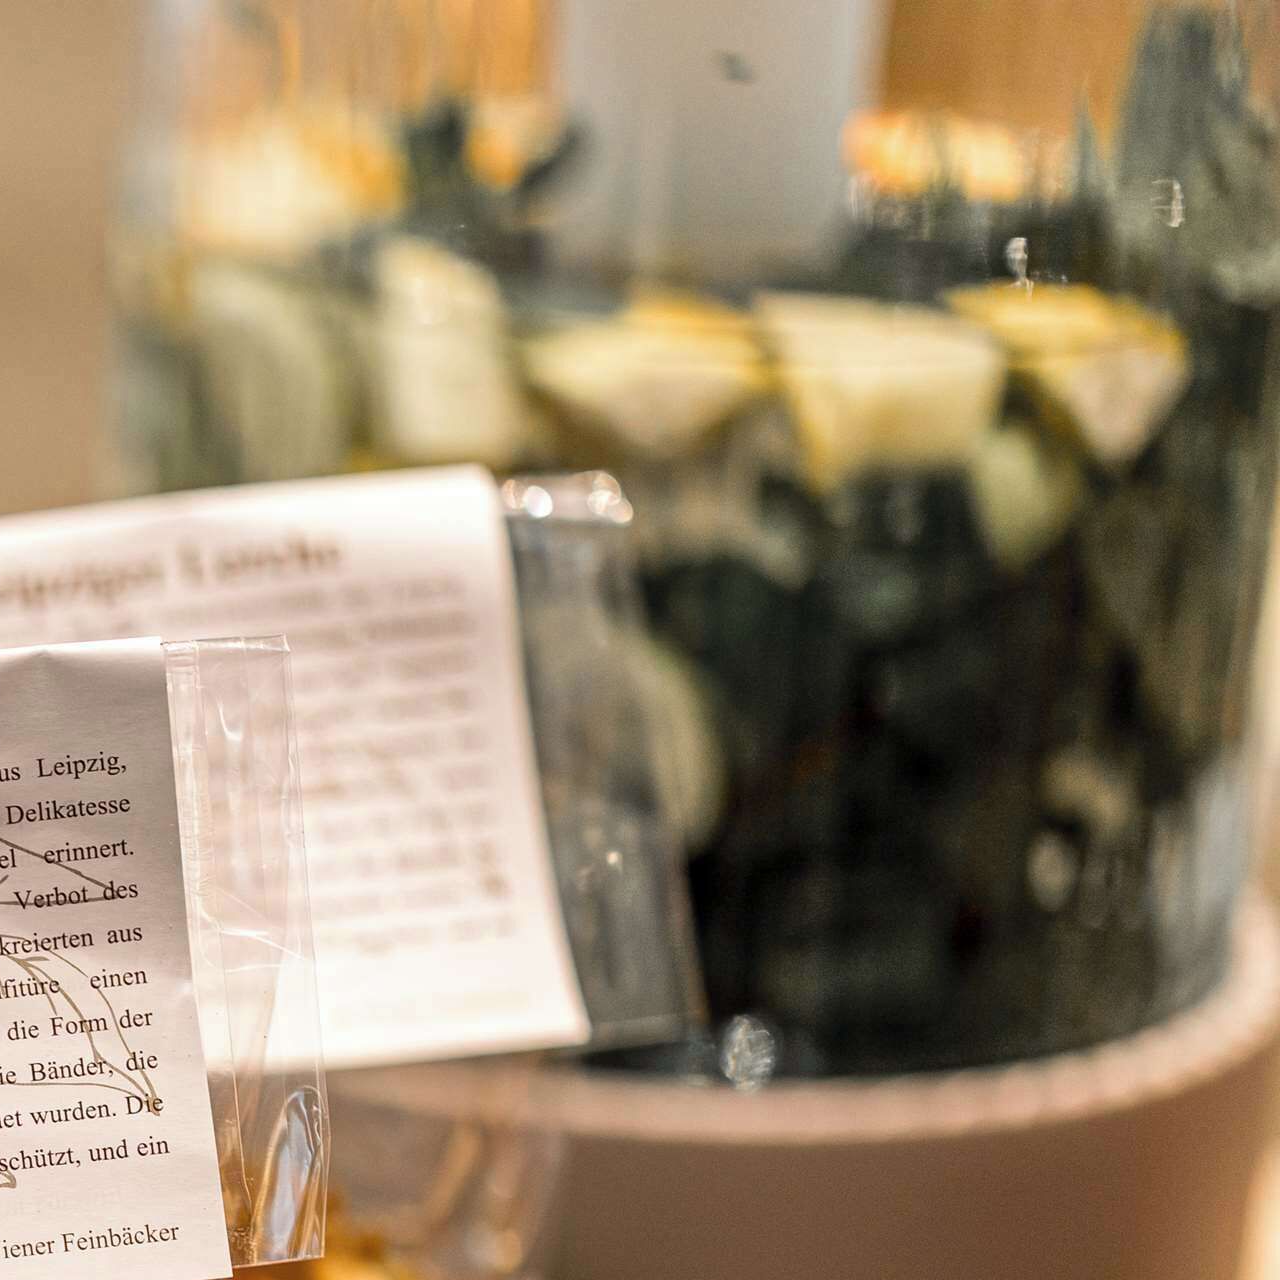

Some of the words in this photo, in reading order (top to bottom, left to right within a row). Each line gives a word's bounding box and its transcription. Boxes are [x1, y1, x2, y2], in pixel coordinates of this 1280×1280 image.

[37, 752, 127, 780] Leipzig,
[5, 798, 131, 825] Delikatesse
[43, 842, 134, 865] erinnert.
[14, 886, 90, 910] Verbot
[102, 880, 139, 901] des
[107, 926, 143, 944] aus
[90, 970, 148, 990] einen
[7, 1020, 39, 1041] die
[49, 1016, 108, 1036] Form
[119, 1009, 153, 1029] der
[29, 1057, 114, 1086] Bänder,
[125, 1050, 158, 1072] die
[29, 1100, 117, 1125] wurden.
[125, 1093, 164, 1115] Die
[88, 1138, 129, 1162] und
[136, 1135, 170, 1157] ein
[62, 1224, 180, 1253] Feinbäcker
